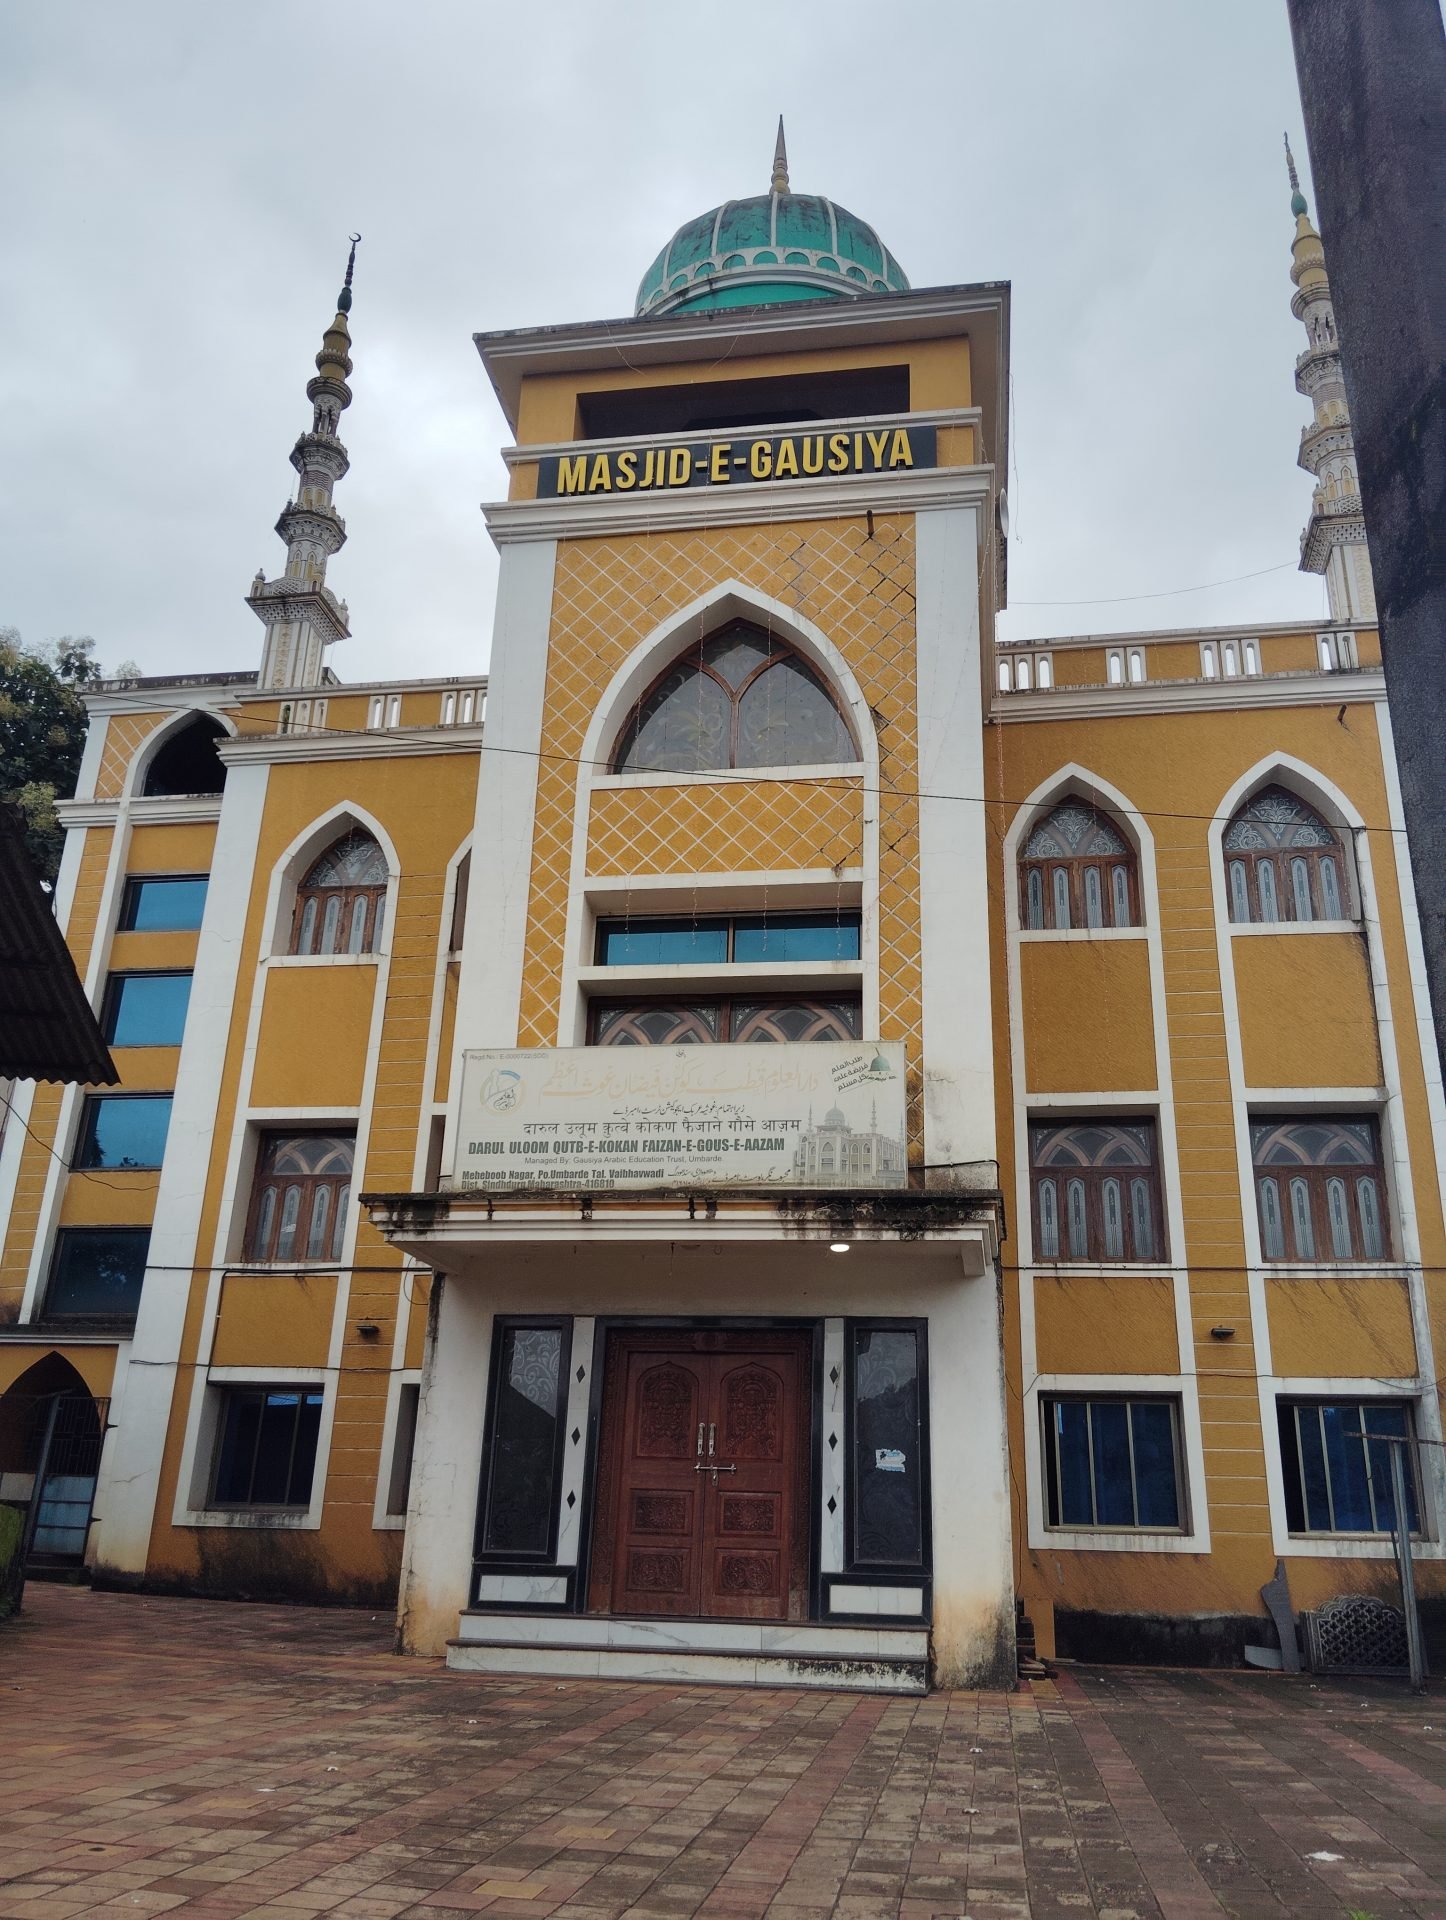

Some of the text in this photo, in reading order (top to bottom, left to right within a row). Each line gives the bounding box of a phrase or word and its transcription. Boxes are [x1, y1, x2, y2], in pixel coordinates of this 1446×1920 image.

[557, 429, 914, 495] MASJID-E-GAUSIYA
[468, 1138, 785, 1154] DARUL ULOOM QUTB-E-KOKAN FAIZAN-E-GOUS-E-AAZAM
[524, 1156, 557, 1165] Managed
[573, 1156, 602, 1165] Gausiya
[604, 1155, 627, 1164] Arabic
[628, 1155, 665, 1164] Education
[462, 1170, 506, 1180] Meheboob
[609, 1168, 665, 1179] Vaibhavwadi
